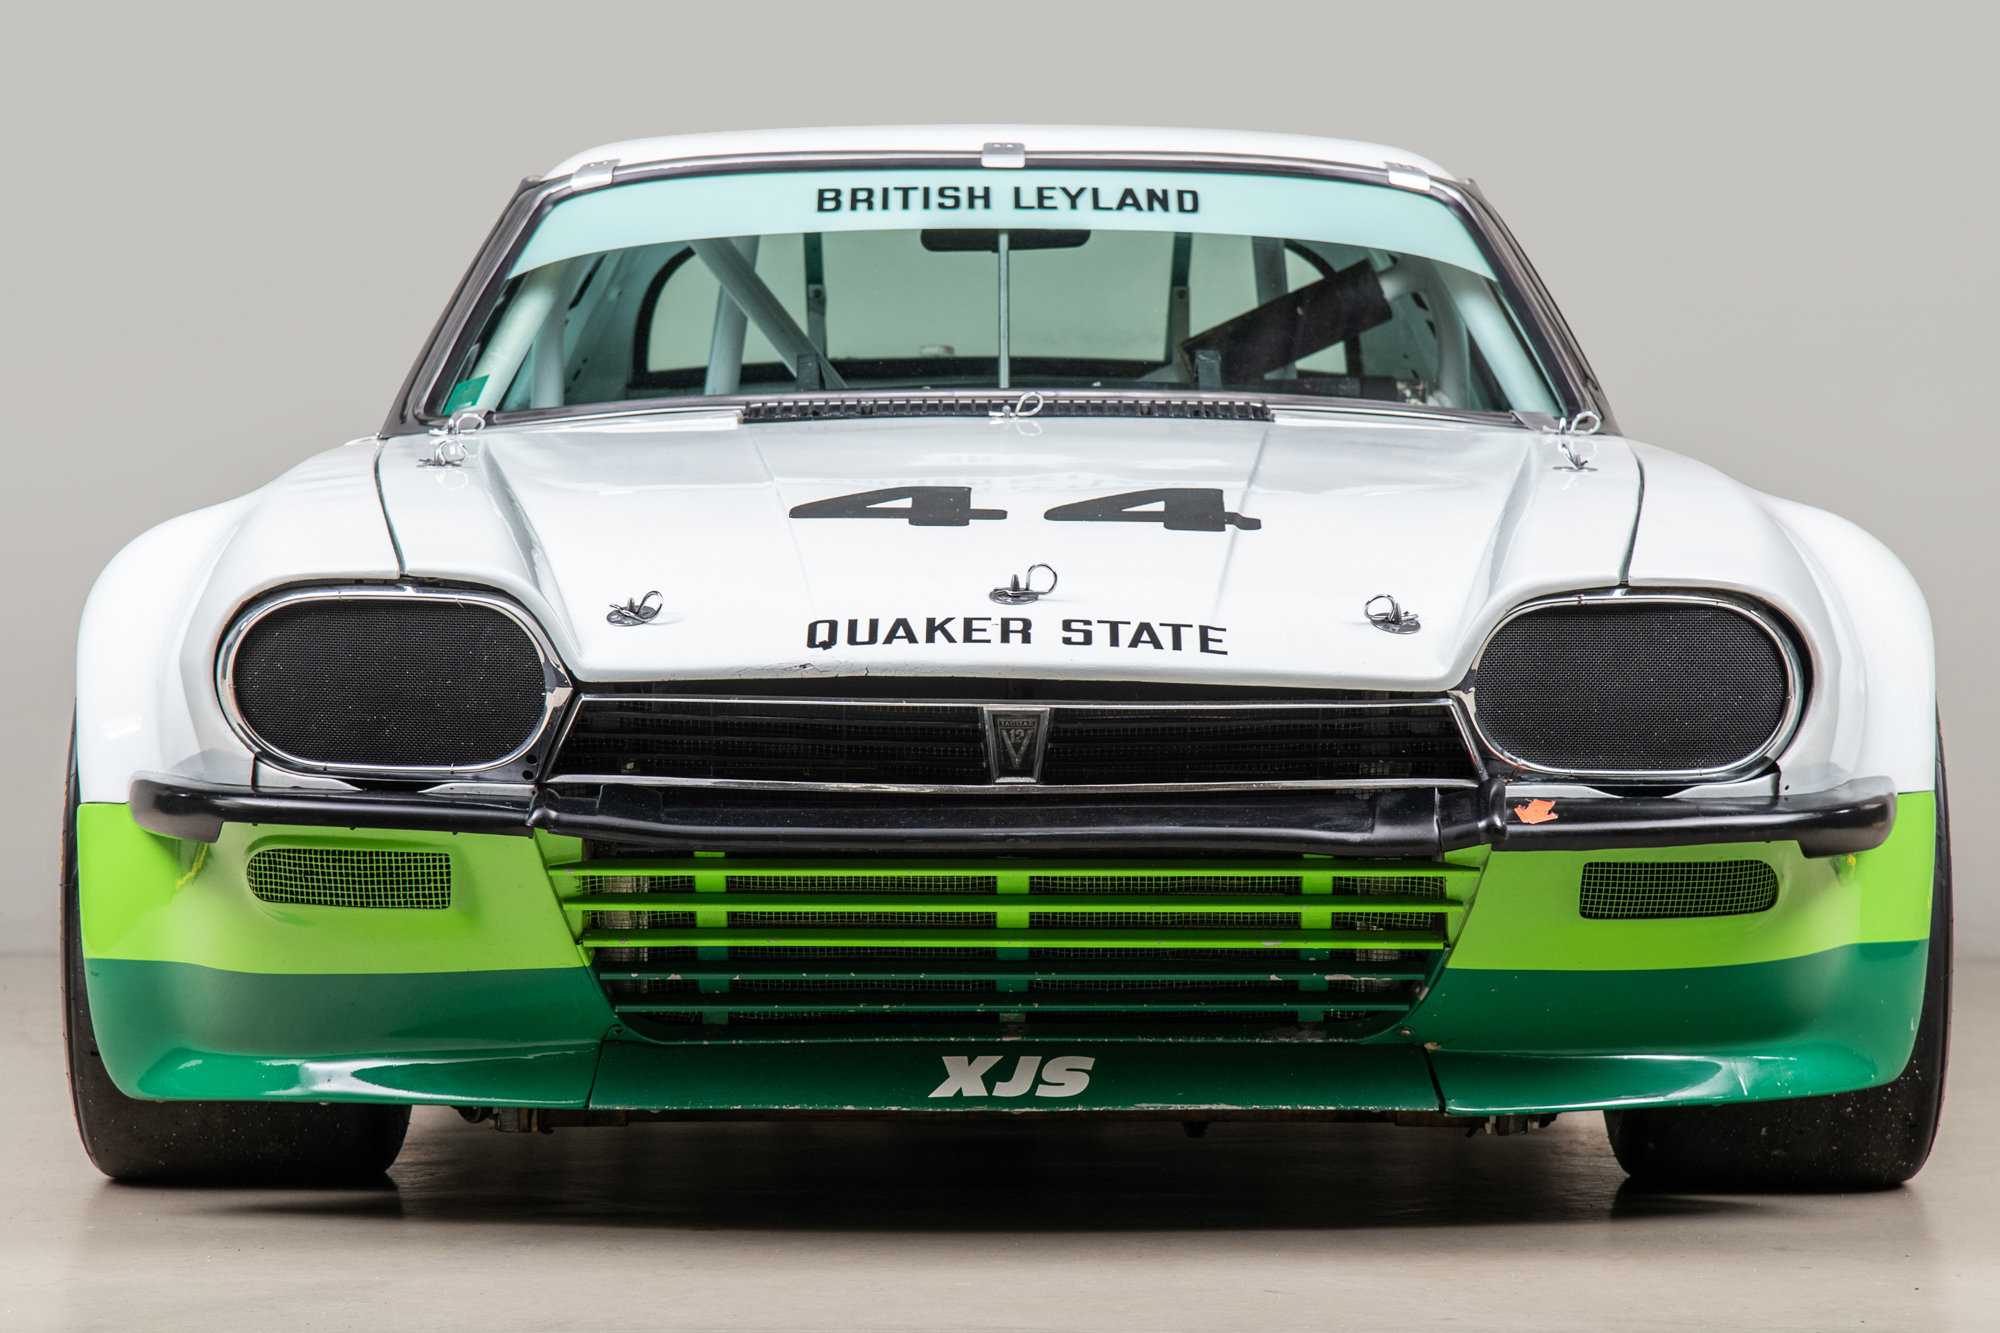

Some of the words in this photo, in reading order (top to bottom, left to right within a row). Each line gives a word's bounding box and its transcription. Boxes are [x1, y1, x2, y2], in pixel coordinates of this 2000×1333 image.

[818, 187, 991, 212] BRITISH
[1014, 187, 1199, 213] LEYLAND
[789, 486, 1262, 532] 44
[806, 617, 1033, 650] QUAKER
[1062, 618, 1229, 655] STATE
[928, 1056, 1096, 1098] XJS
